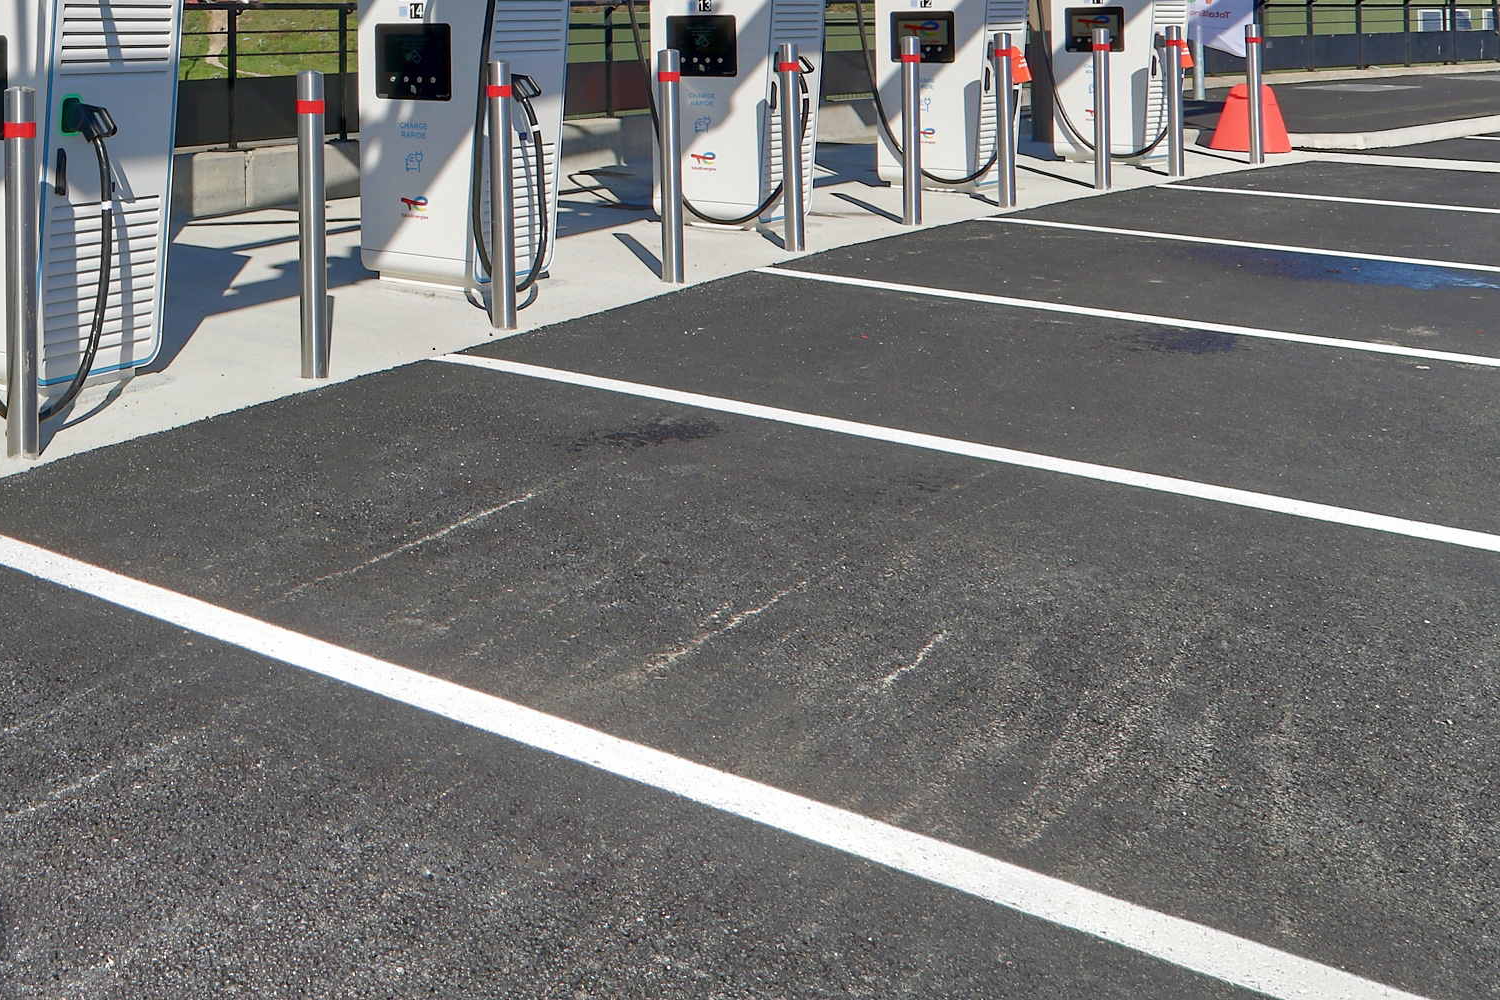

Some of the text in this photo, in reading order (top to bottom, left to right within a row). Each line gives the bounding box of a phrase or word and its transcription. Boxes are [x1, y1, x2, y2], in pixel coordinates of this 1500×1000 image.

[699, 0, 711, 11] 13
[410, 4, 423, 18] 14
[399, 122, 428, 130] CHARGE
[401, 131, 427, 139] RAPIDE
